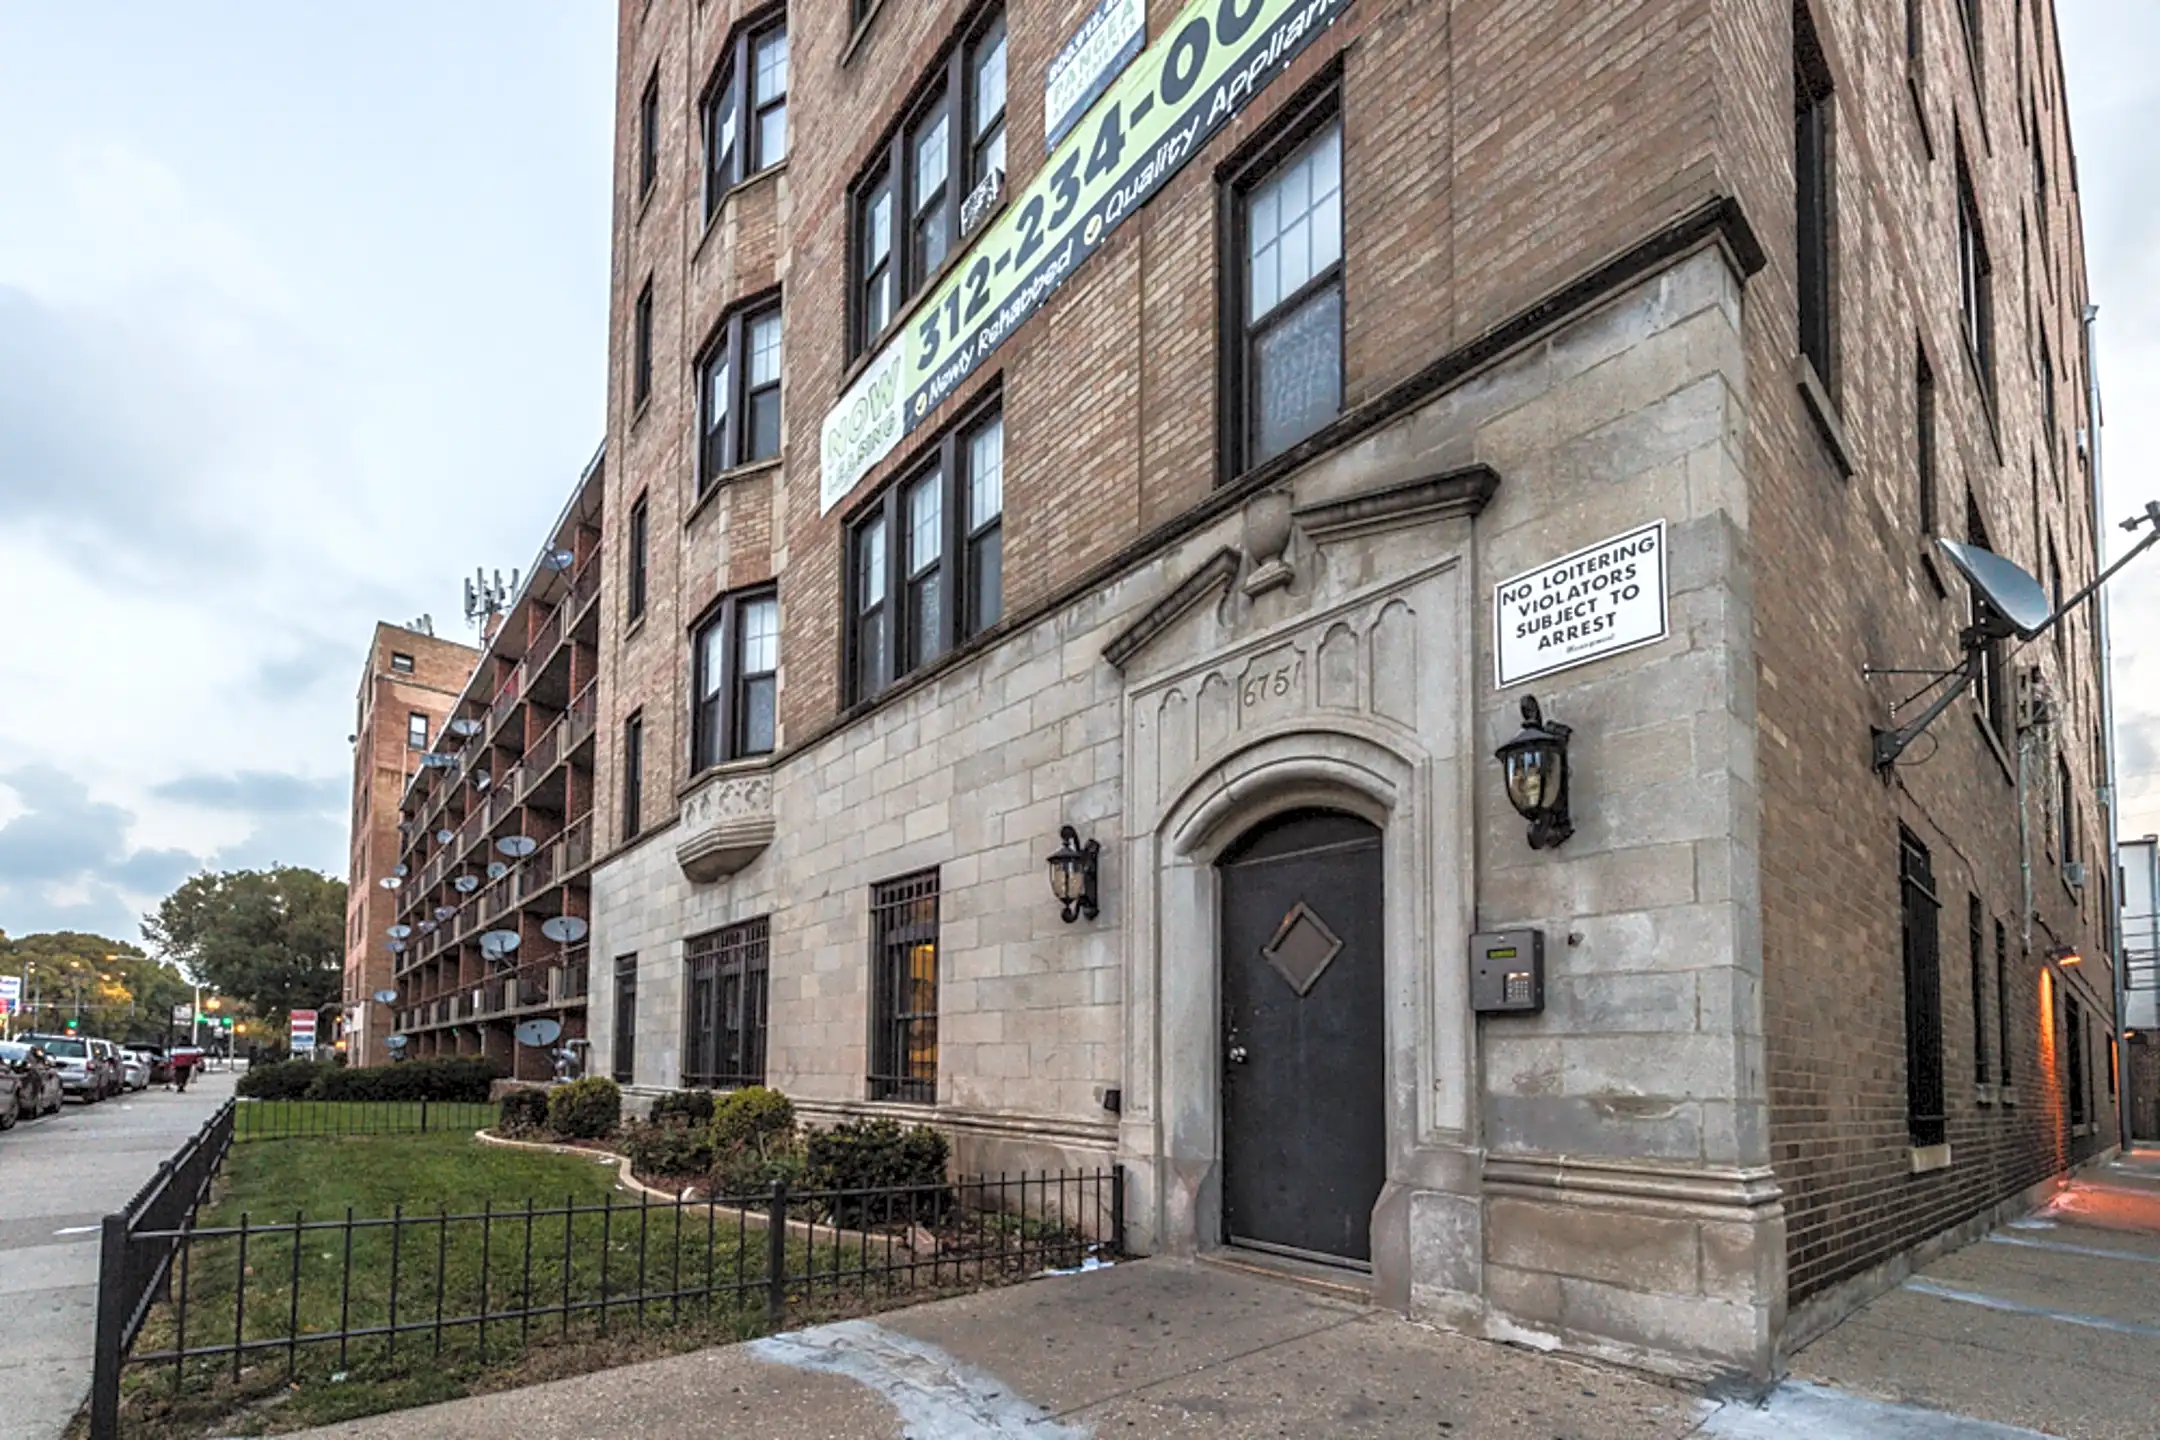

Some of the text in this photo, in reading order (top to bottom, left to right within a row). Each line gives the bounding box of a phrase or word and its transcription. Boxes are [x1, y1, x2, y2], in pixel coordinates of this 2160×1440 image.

[977, 237, 1074, 357] Rehabbed
[1105, 114, 1200, 223] Quality
[1206, 0, 1336, 126] Applian
[827, 355, 902, 470] NOW
[1502, 536, 1656, 606] NO LOITERING
[1518, 563, 1637, 617] VIOLATORS
[1516, 584, 1640, 639] SUBJECT TO
[1537, 612, 1617, 651] ARREST
[1243, 660, 1302, 707] 6751
